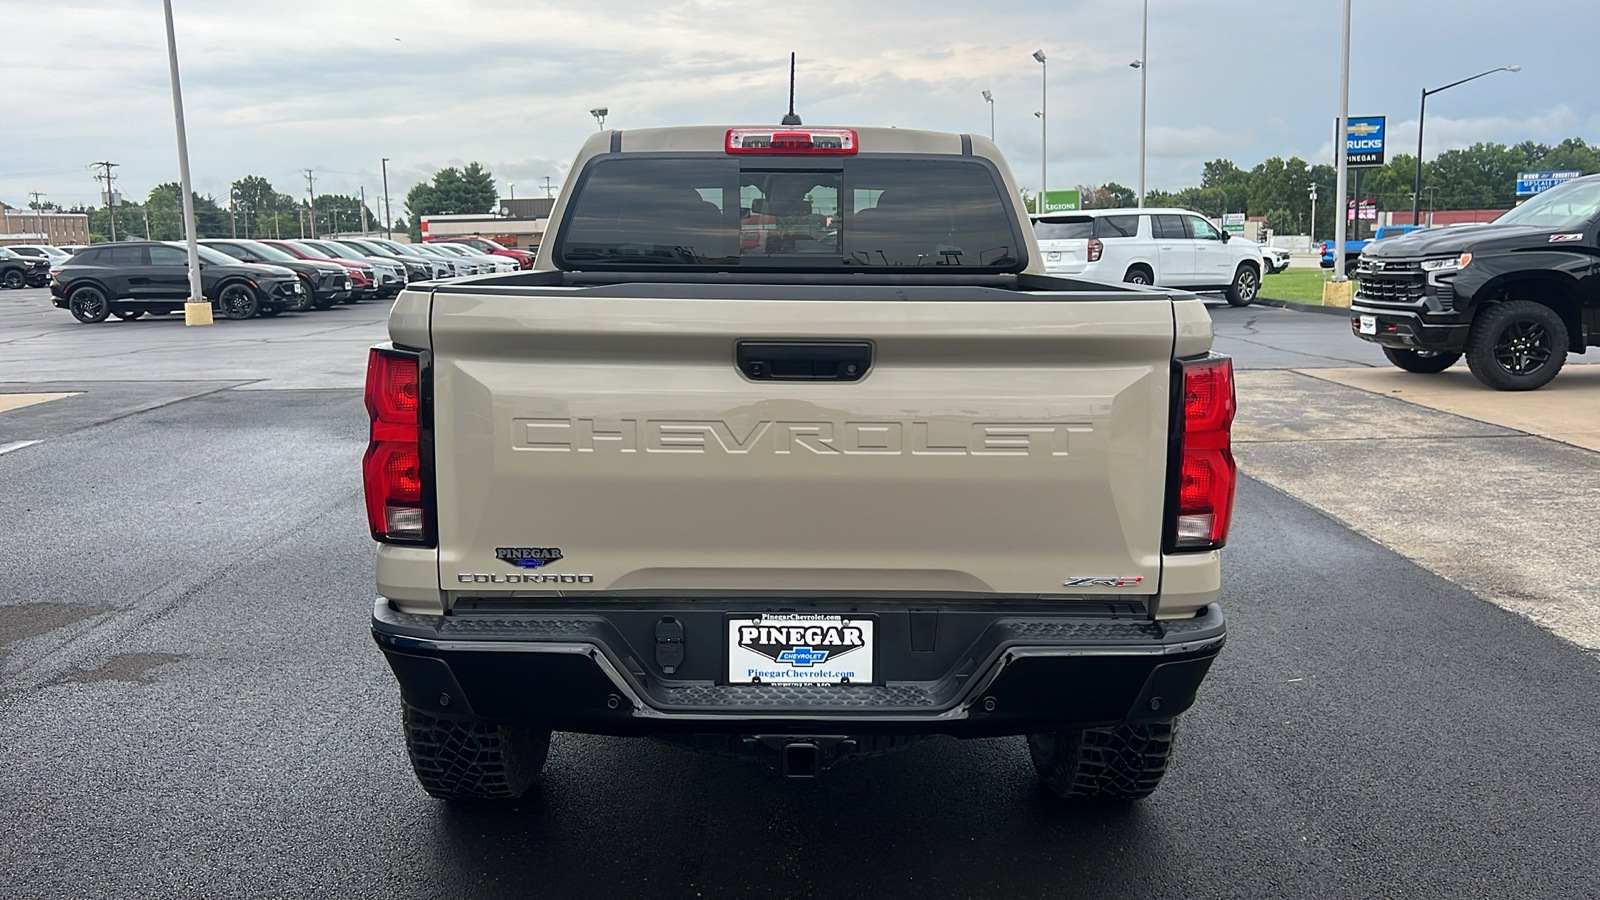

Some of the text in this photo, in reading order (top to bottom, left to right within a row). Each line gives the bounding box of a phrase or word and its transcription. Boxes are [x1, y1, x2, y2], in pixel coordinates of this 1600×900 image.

[1347, 139, 1382, 149] RUCKS
[512, 418, 1093, 454] CHEVROLET
[497, 548, 562, 559] PINEGAR
[458, 573, 594, 583] COLORADO
[1063, 576, 1144, 587] ZR2
[761, 613, 842, 621] PinegarChevrolet.com
[741, 627, 862, 645] PINEGAR
[748, 669, 855, 678] PinegarChevrolet.com
